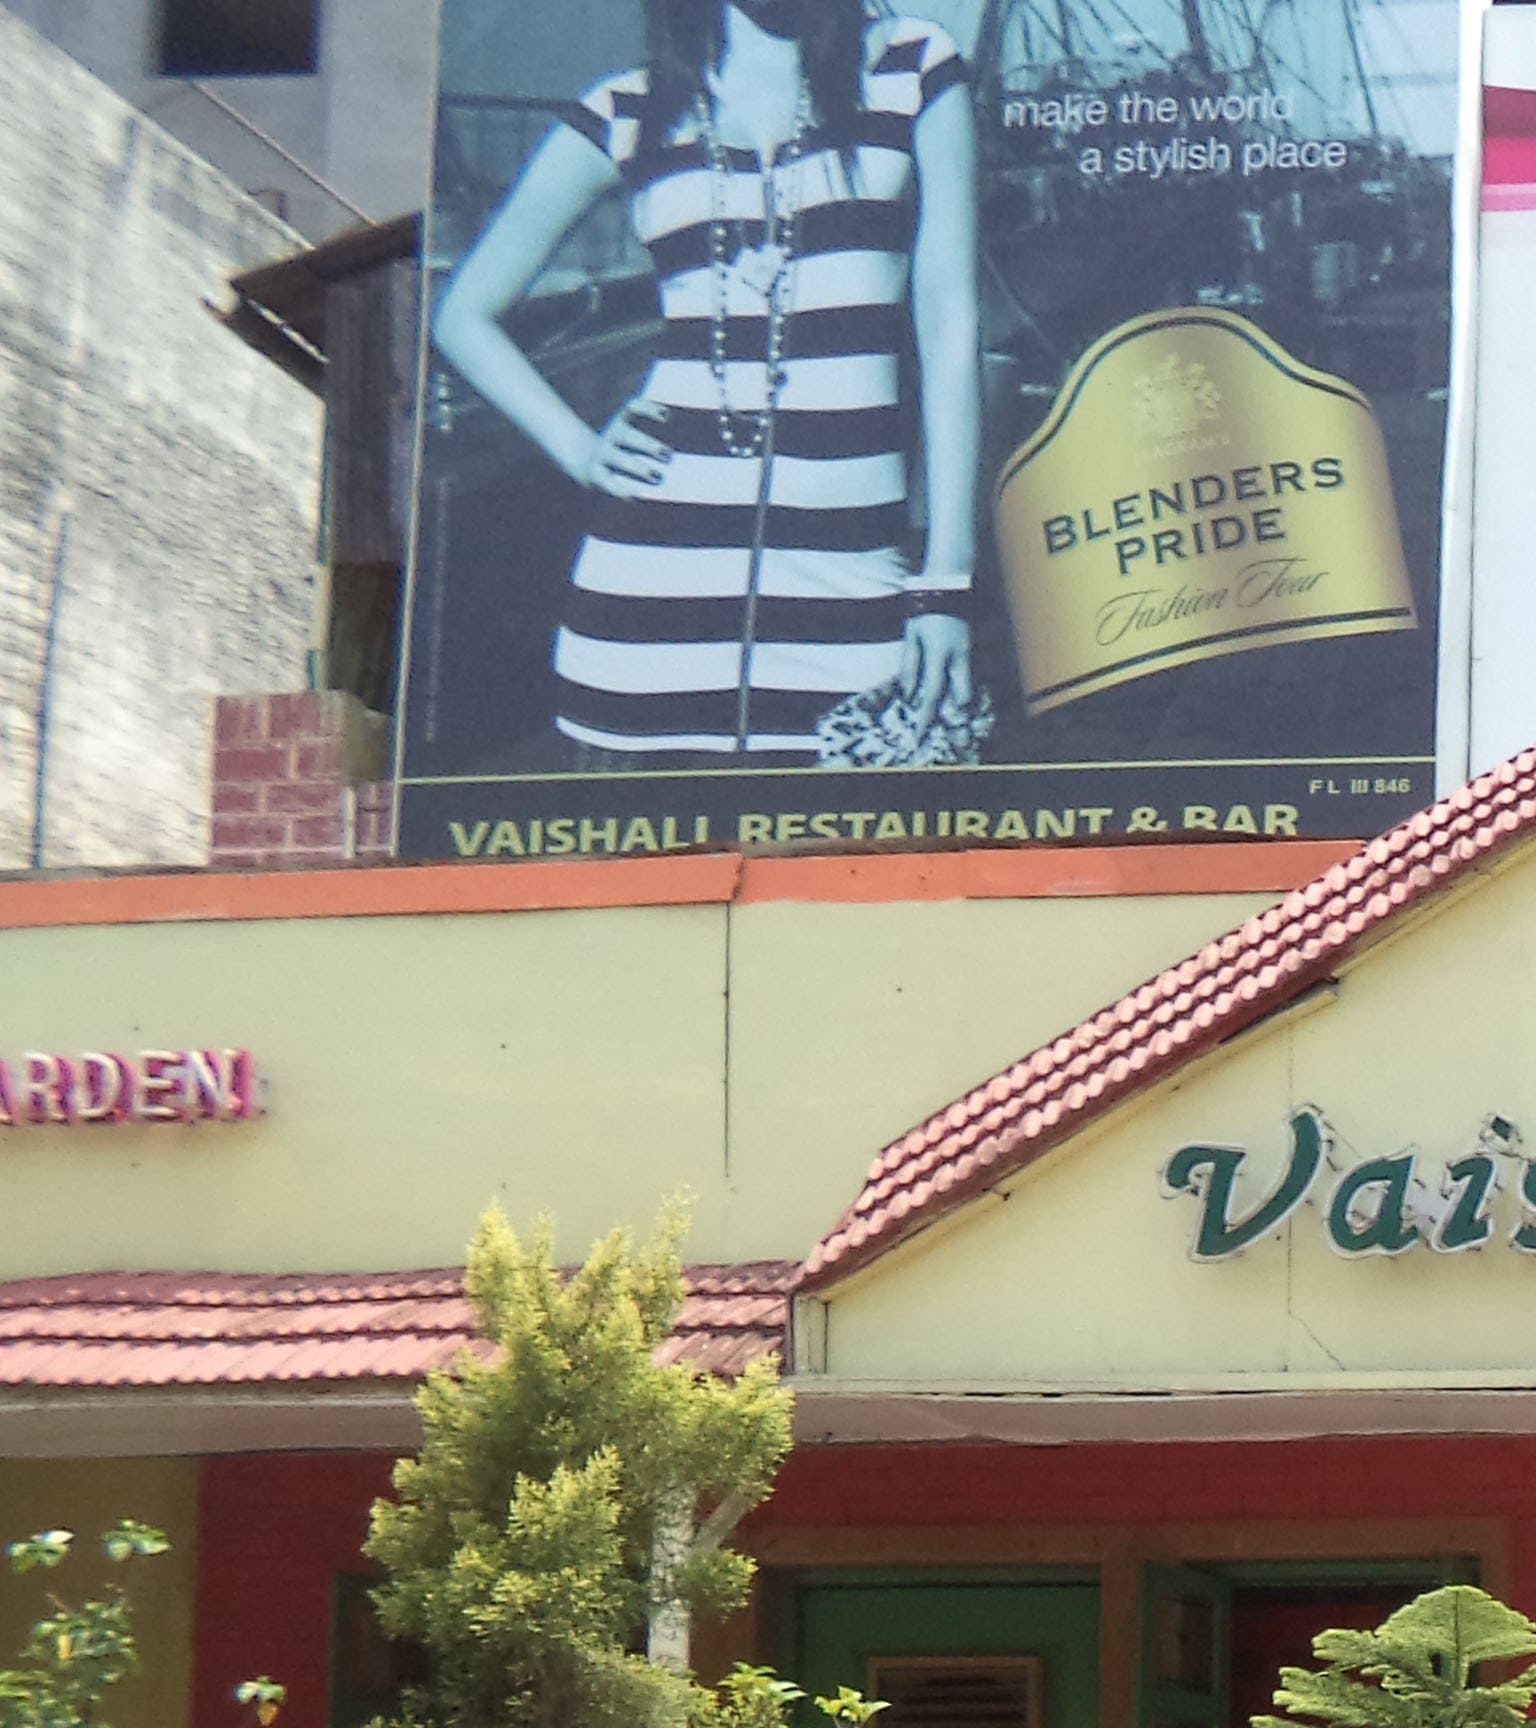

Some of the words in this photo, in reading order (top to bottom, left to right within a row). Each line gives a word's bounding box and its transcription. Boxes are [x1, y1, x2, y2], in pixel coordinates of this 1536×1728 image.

[1003, 96, 1109, 127] make
[1120, 91, 1178, 122] the
[1191, 88, 1294, 121] world
[1079, 145, 1102, 173] a
[1114, 137, 1230, 178] stylish
[1241, 135, 1348, 175] place
[1042, 457, 1345, 555] BLENDERS
[1115, 508, 1286, 576] PRIDE
[1096, 585, 1229, 646] Fashion
[1237, 558, 1329, 609] Tour
[1375, 778, 1411, 795] 846
[450, 815, 711, 857] VAISHALI
[738, 806, 1113, 843] RESTAURANT
[1126, 806, 1168, 832] &
[1183, 803, 1300, 837] BAR
